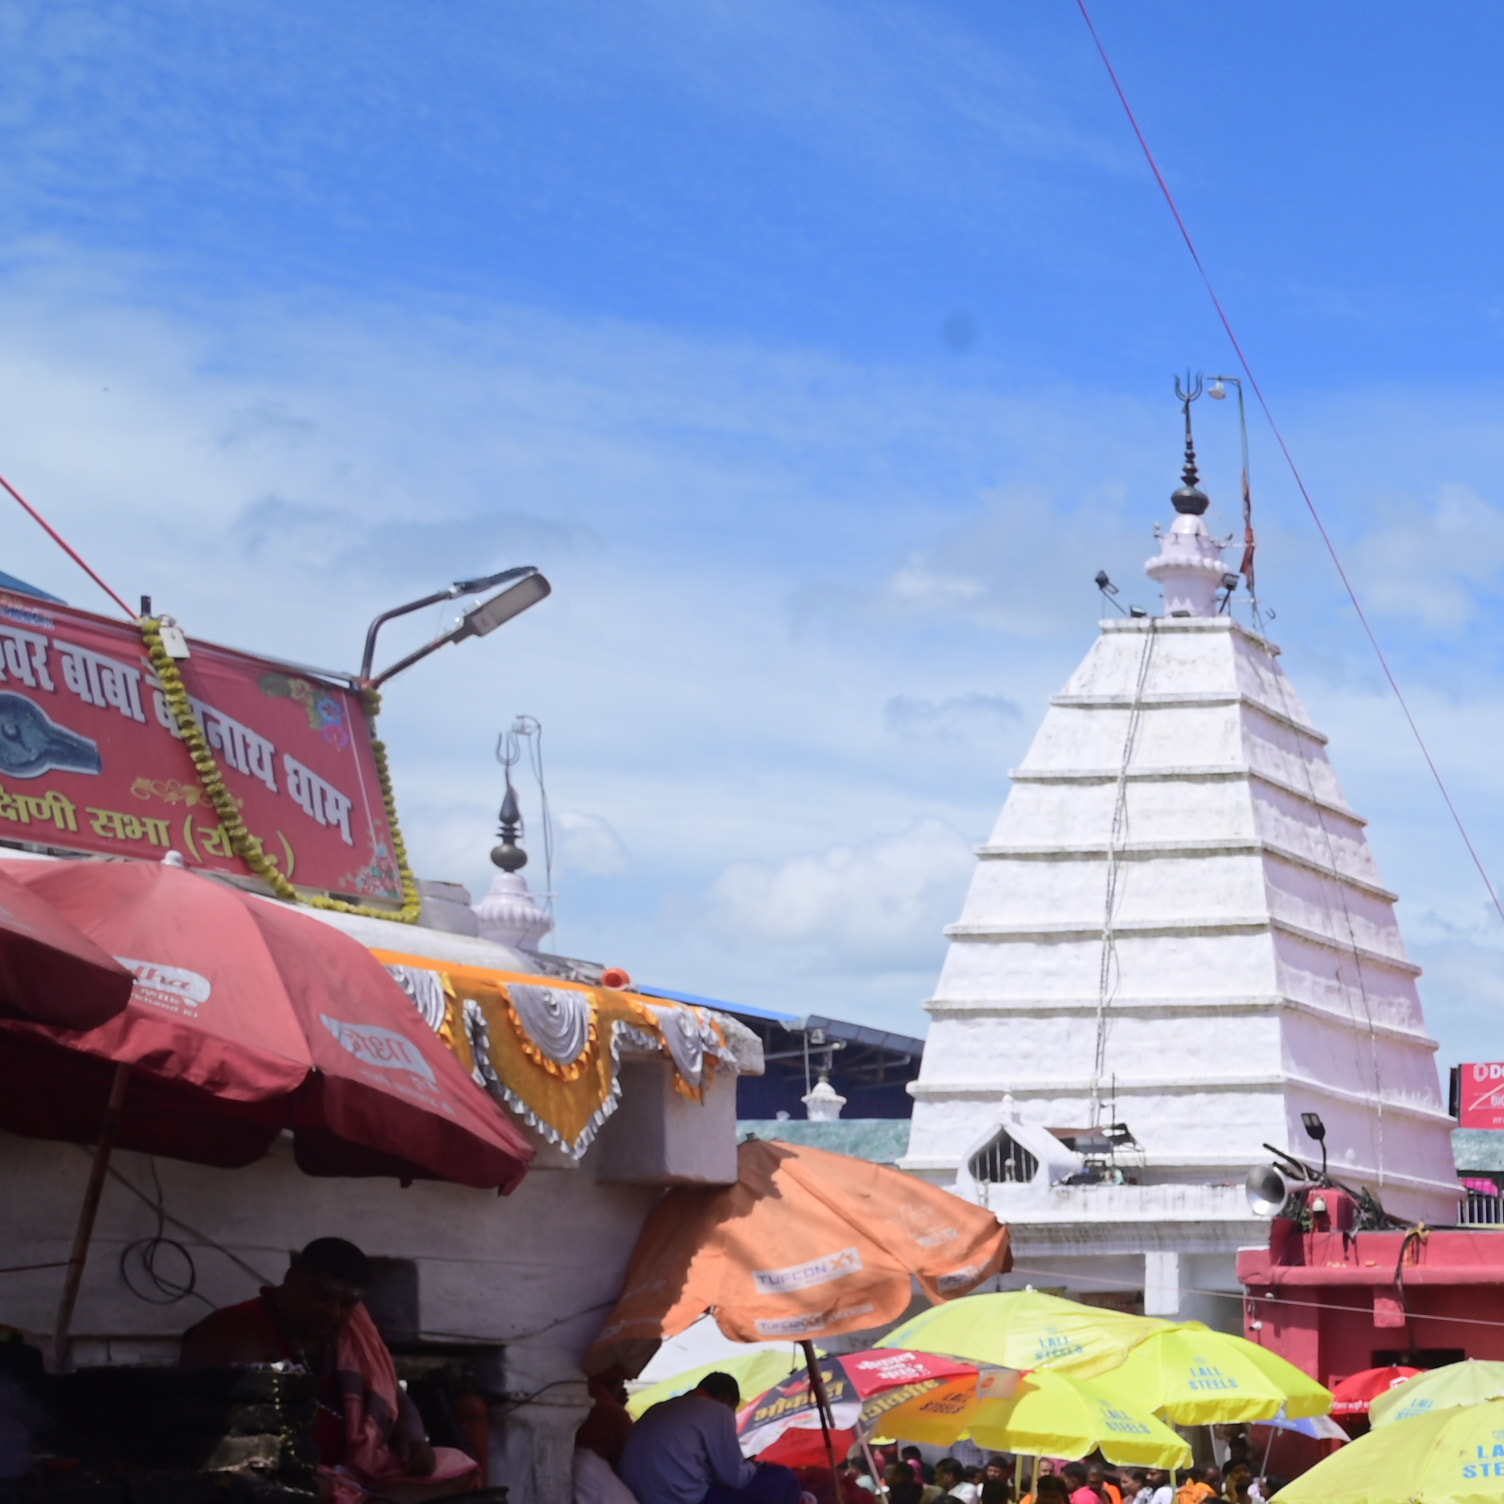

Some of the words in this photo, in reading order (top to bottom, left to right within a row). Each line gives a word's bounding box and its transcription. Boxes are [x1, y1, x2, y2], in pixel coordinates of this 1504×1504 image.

[54, 638, 146, 724] बाबा
[283, 753, 354, 846] धाम
[86, 805, 172, 848] सभा
[757, 1265, 828, 1287] TUFCON
[1190, 1367, 1224, 1379] LALL
[1188, 1378, 1239, 1391] STEELS
